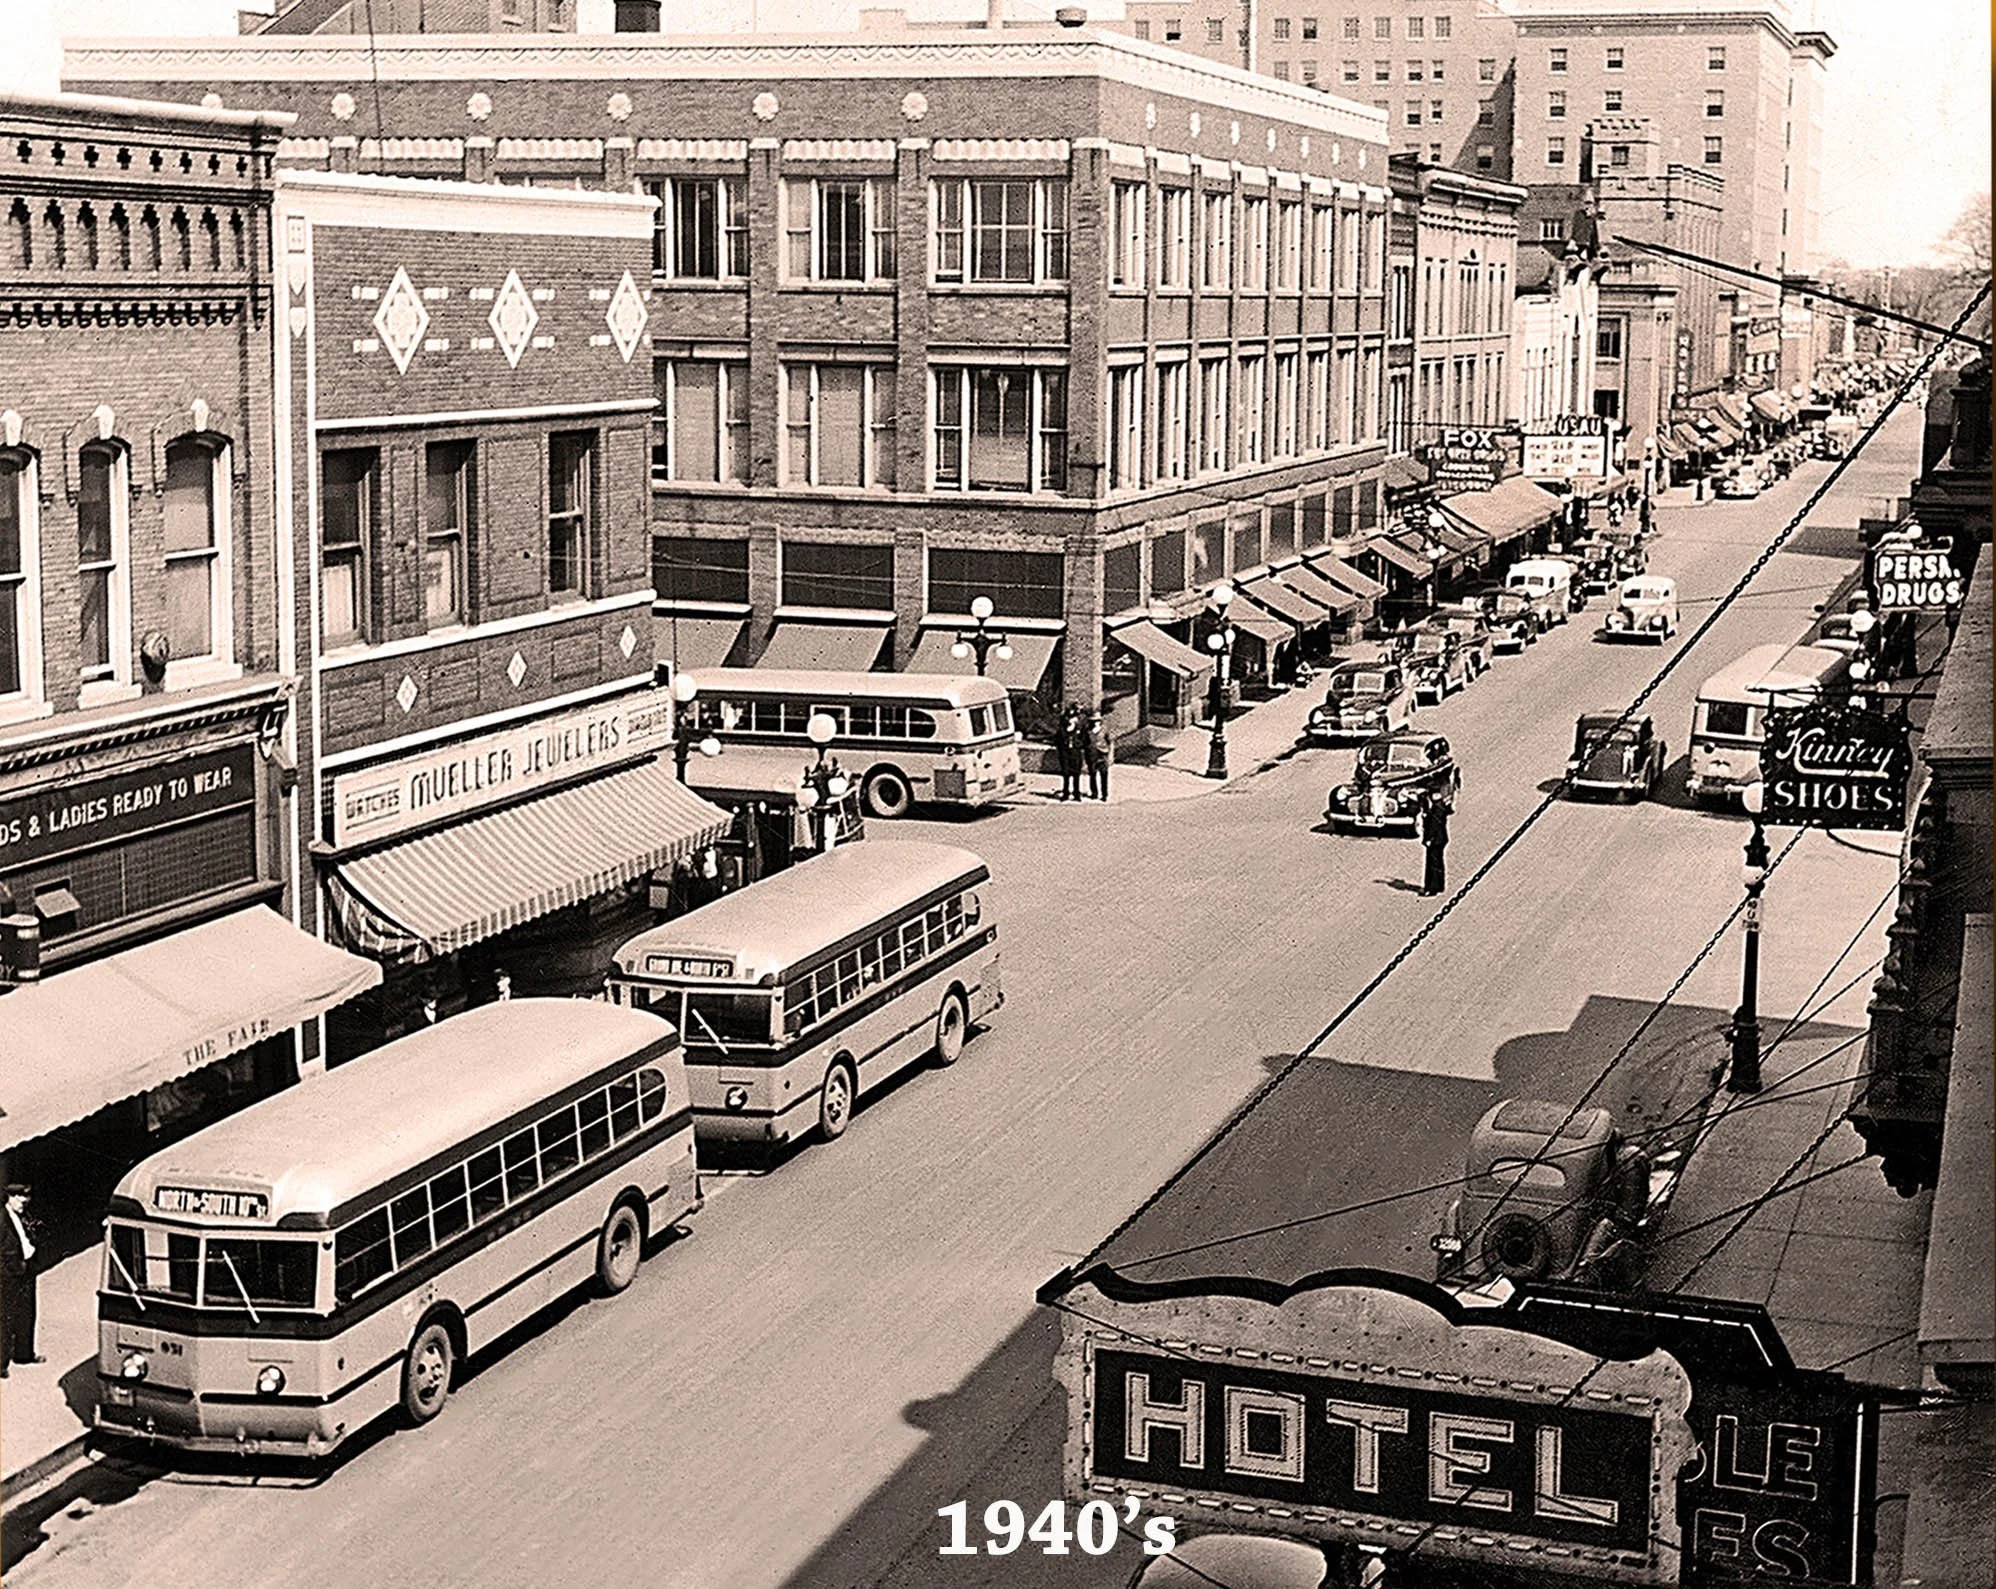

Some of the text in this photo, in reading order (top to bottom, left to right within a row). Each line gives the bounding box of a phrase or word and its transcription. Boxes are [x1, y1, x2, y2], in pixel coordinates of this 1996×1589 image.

[1444, 430, 1493, 449] FOX
[1882, 581, 1961, 605] DRUGS
[411, 748, 512, 809] MUELLER
[523, 716, 619, 775] JEWELERS
[28, 815, 41, 838] &
[50, 798, 108, 833] LADIES
[113, 785, 164, 816] READY
[169, 778, 188, 801] TO
[194, 767, 232, 793] WEAR
[1774, 780, 1894, 811] SHOES
[183, 1018, 269, 1066] THE FAIR
[1124, 1371, 1619, 1527] HOTEL
